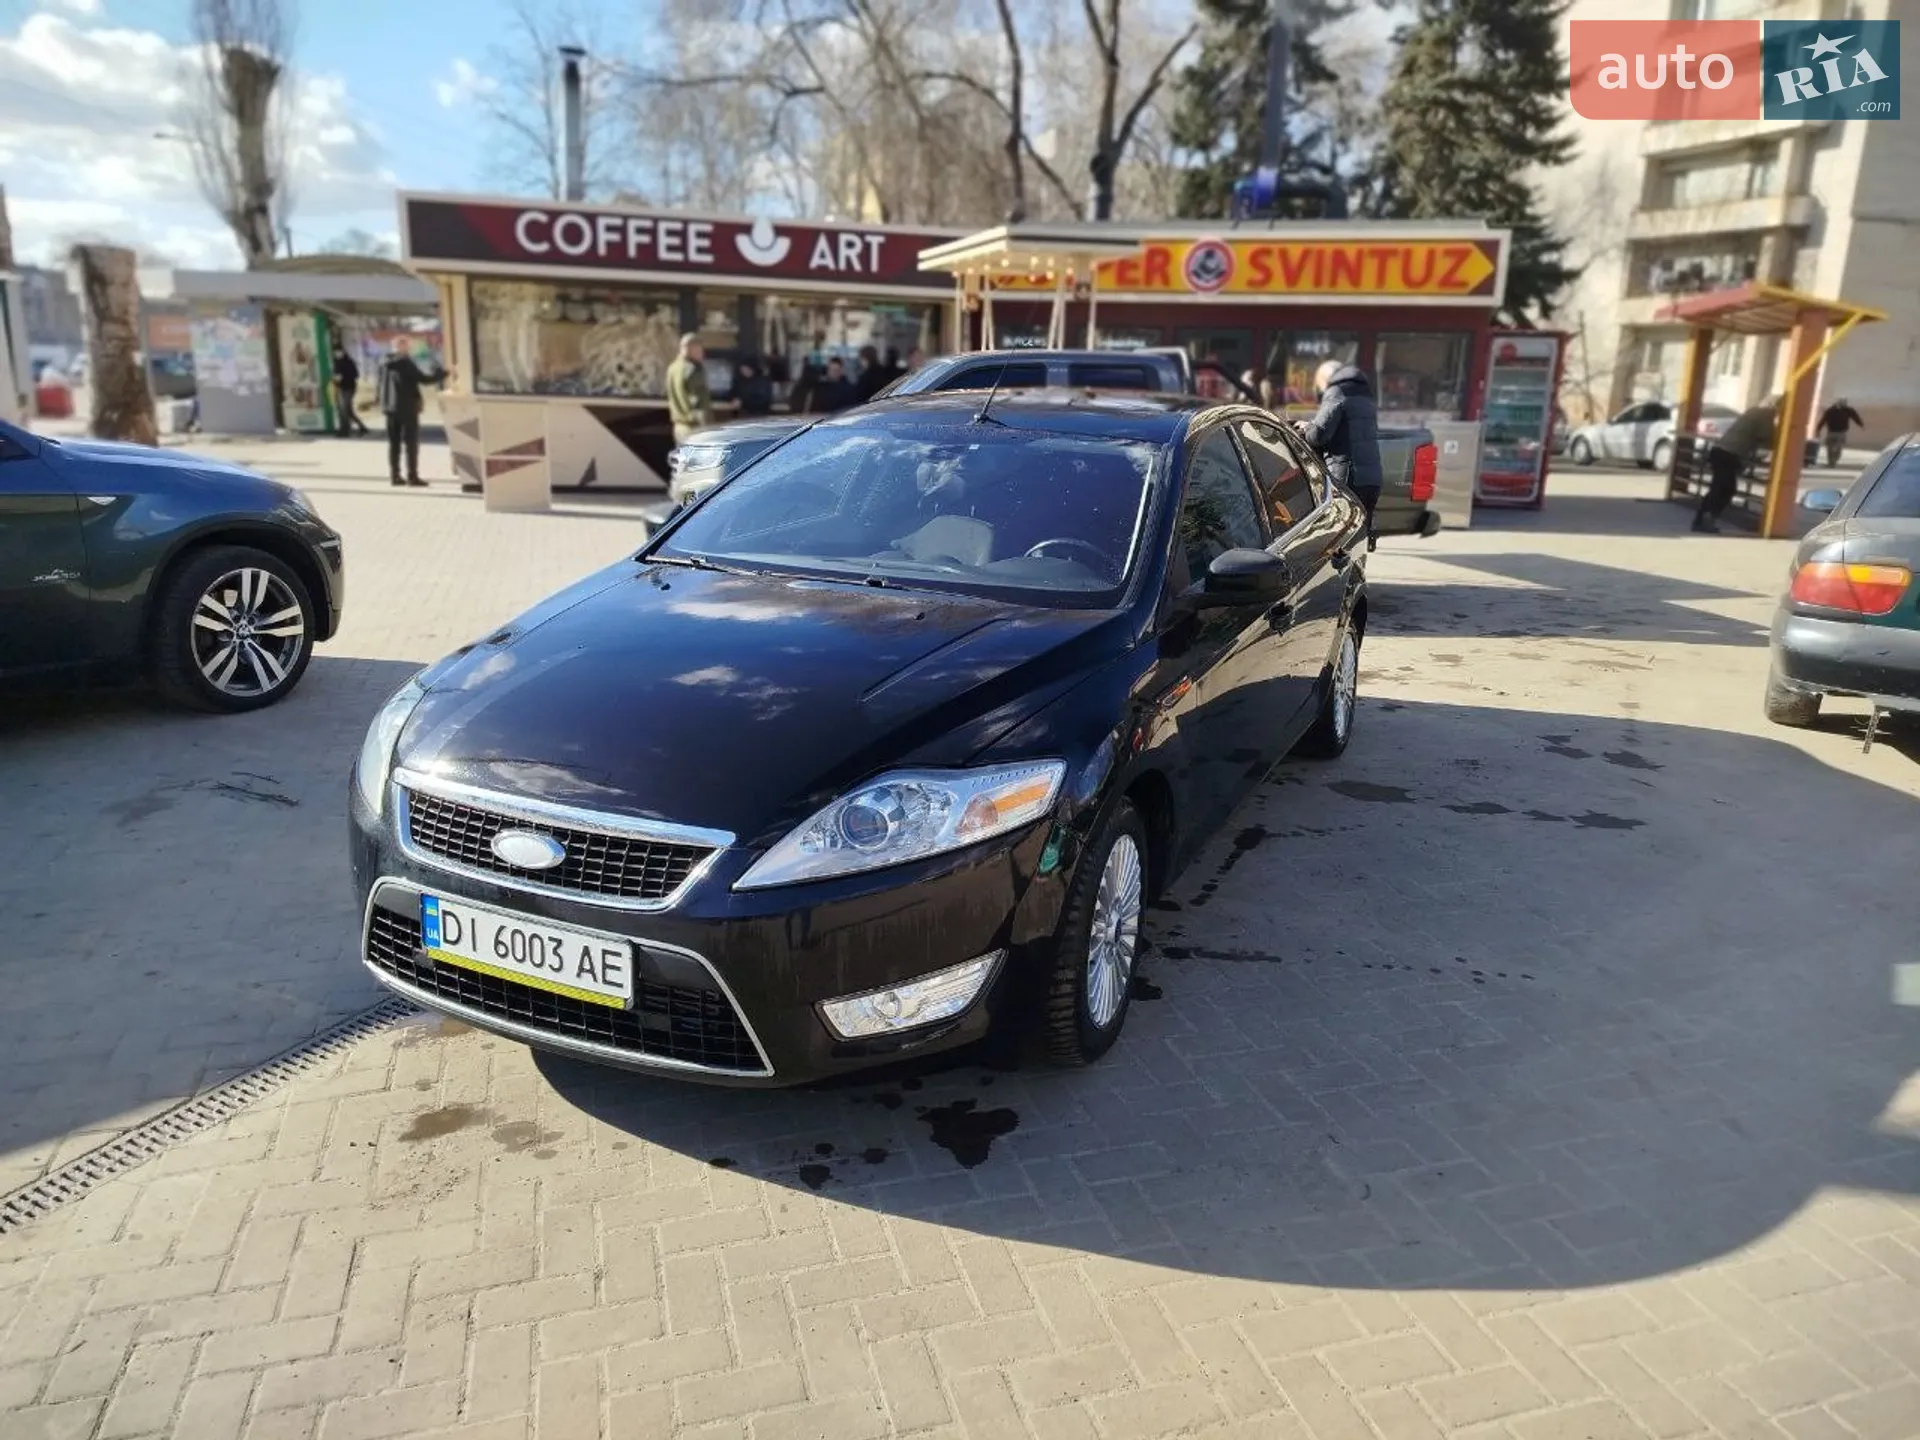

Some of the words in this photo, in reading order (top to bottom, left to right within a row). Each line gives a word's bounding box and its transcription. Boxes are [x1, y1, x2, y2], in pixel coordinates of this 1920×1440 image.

[515, 211, 715, 263] COFFEE
[809, 232, 885, 272] ART
[1246, 247, 1474, 290] SVINTUZ
[426, 927, 439, 941] UA
[442, 909, 477, 952] DI
[493, 925, 564, 973] 6003
[576, 945, 624, 988] AE
